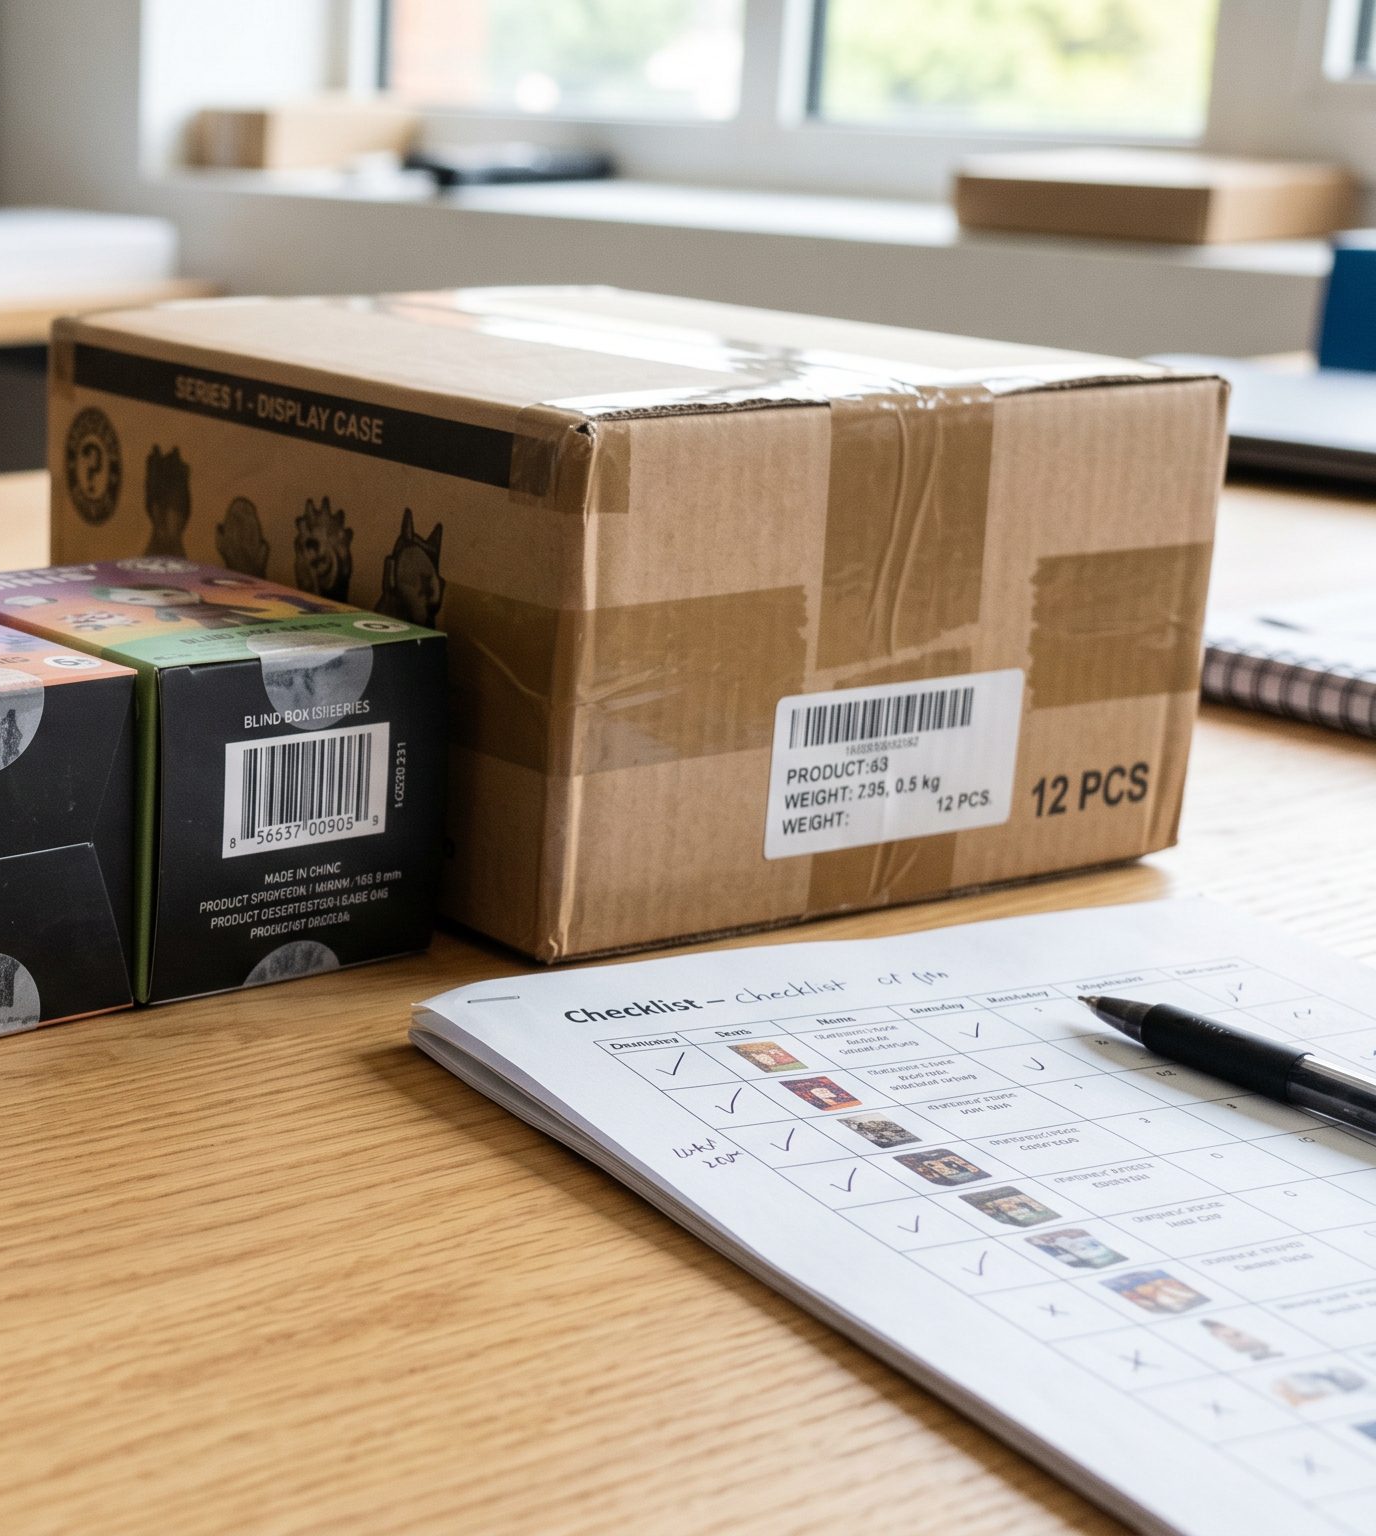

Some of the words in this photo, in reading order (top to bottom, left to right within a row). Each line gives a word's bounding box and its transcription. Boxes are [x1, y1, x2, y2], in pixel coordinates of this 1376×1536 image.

[174, 376, 232, 411] SERIES
[234, 389, 244, 413] 1
[257, 393, 332, 432] DISPLAY
[333, 410, 384, 446] CASE
[244, 711, 282, 729] BLIND
[284, 708, 310, 723] BOX
[784, 785, 854, 811] WEIGHT:
[922, 774, 941, 793] kg
[1031, 774, 1070, 818] 12
[1078, 761, 1150, 811] PCS
[936, 795, 953, 812] 12
[229, 837, 237, 849] 8
[308, 815, 355, 837] 00905
[782, 810, 850, 836] WEIGHT:
[264, 870, 295, 885] MADE
[296, 867, 308, 879] IN
[199, 894, 249, 914] PRODUCT
[210, 910, 260, 929] PRODUCT
[563, 998, 703, 1024] Checklist
